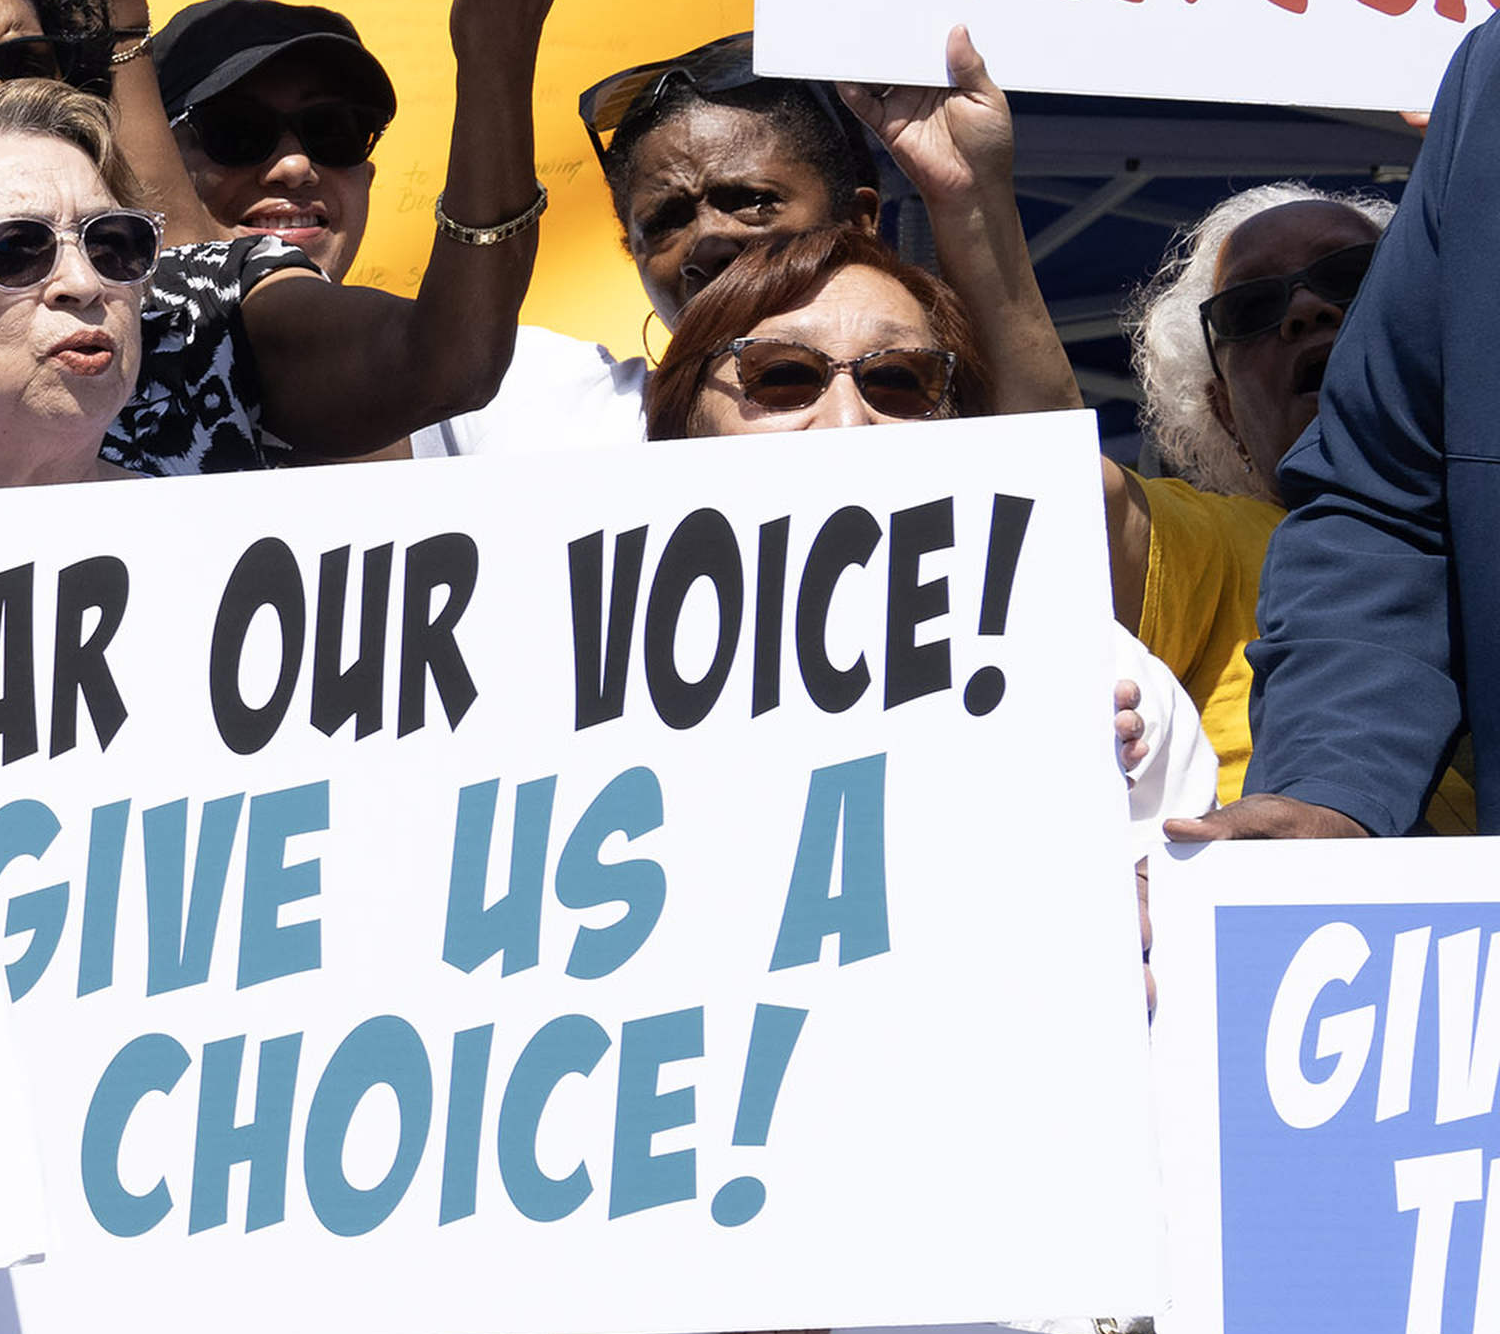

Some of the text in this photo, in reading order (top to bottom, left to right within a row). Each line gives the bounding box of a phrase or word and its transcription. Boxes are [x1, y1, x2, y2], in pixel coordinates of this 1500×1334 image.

[210, 533, 478, 755] OUR
[568, 493, 1035, 731] VOICE!
[442, 767, 666, 979] US
[769, 753, 889, 971] A
[82, 1004, 808, 1237] CHOICE!
